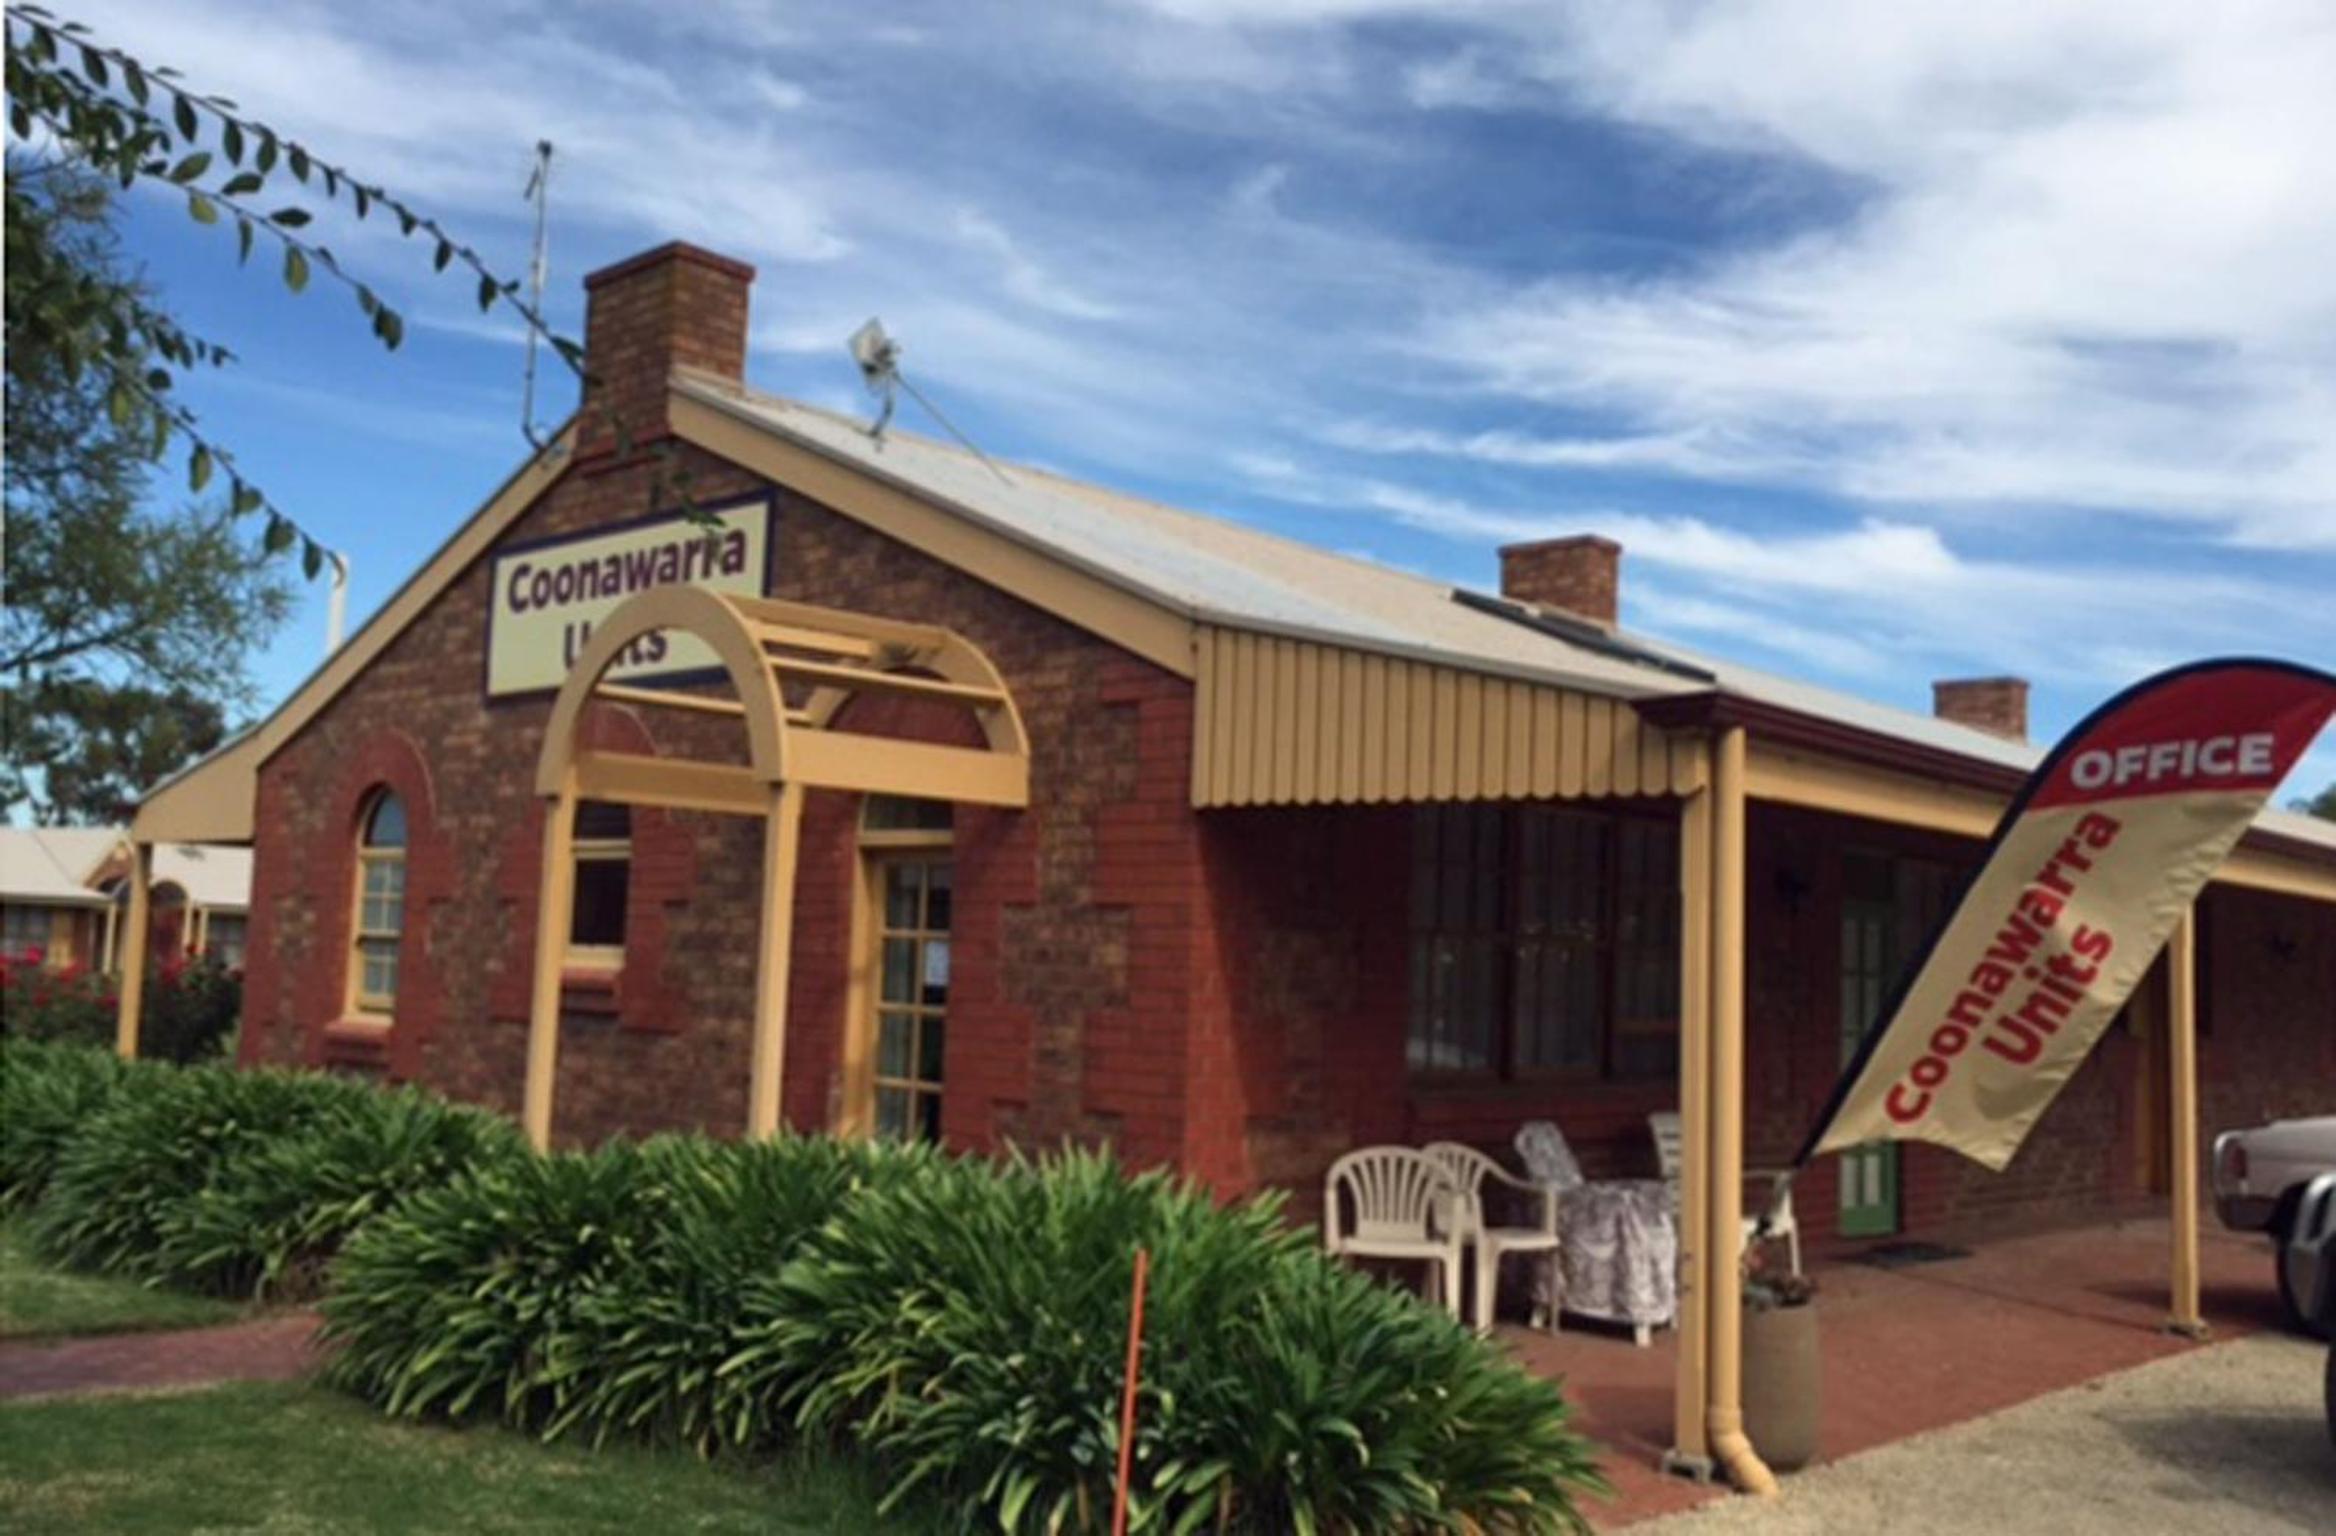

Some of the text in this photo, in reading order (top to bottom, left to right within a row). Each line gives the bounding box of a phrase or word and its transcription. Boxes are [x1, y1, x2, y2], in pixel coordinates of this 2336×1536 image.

[507, 528, 747, 613] Coonawarra
[2071, 734, 2274, 788] OFFICE
[1885, 810, 2122, 1124] Coonawarra
[1982, 924, 2114, 1065] Units
